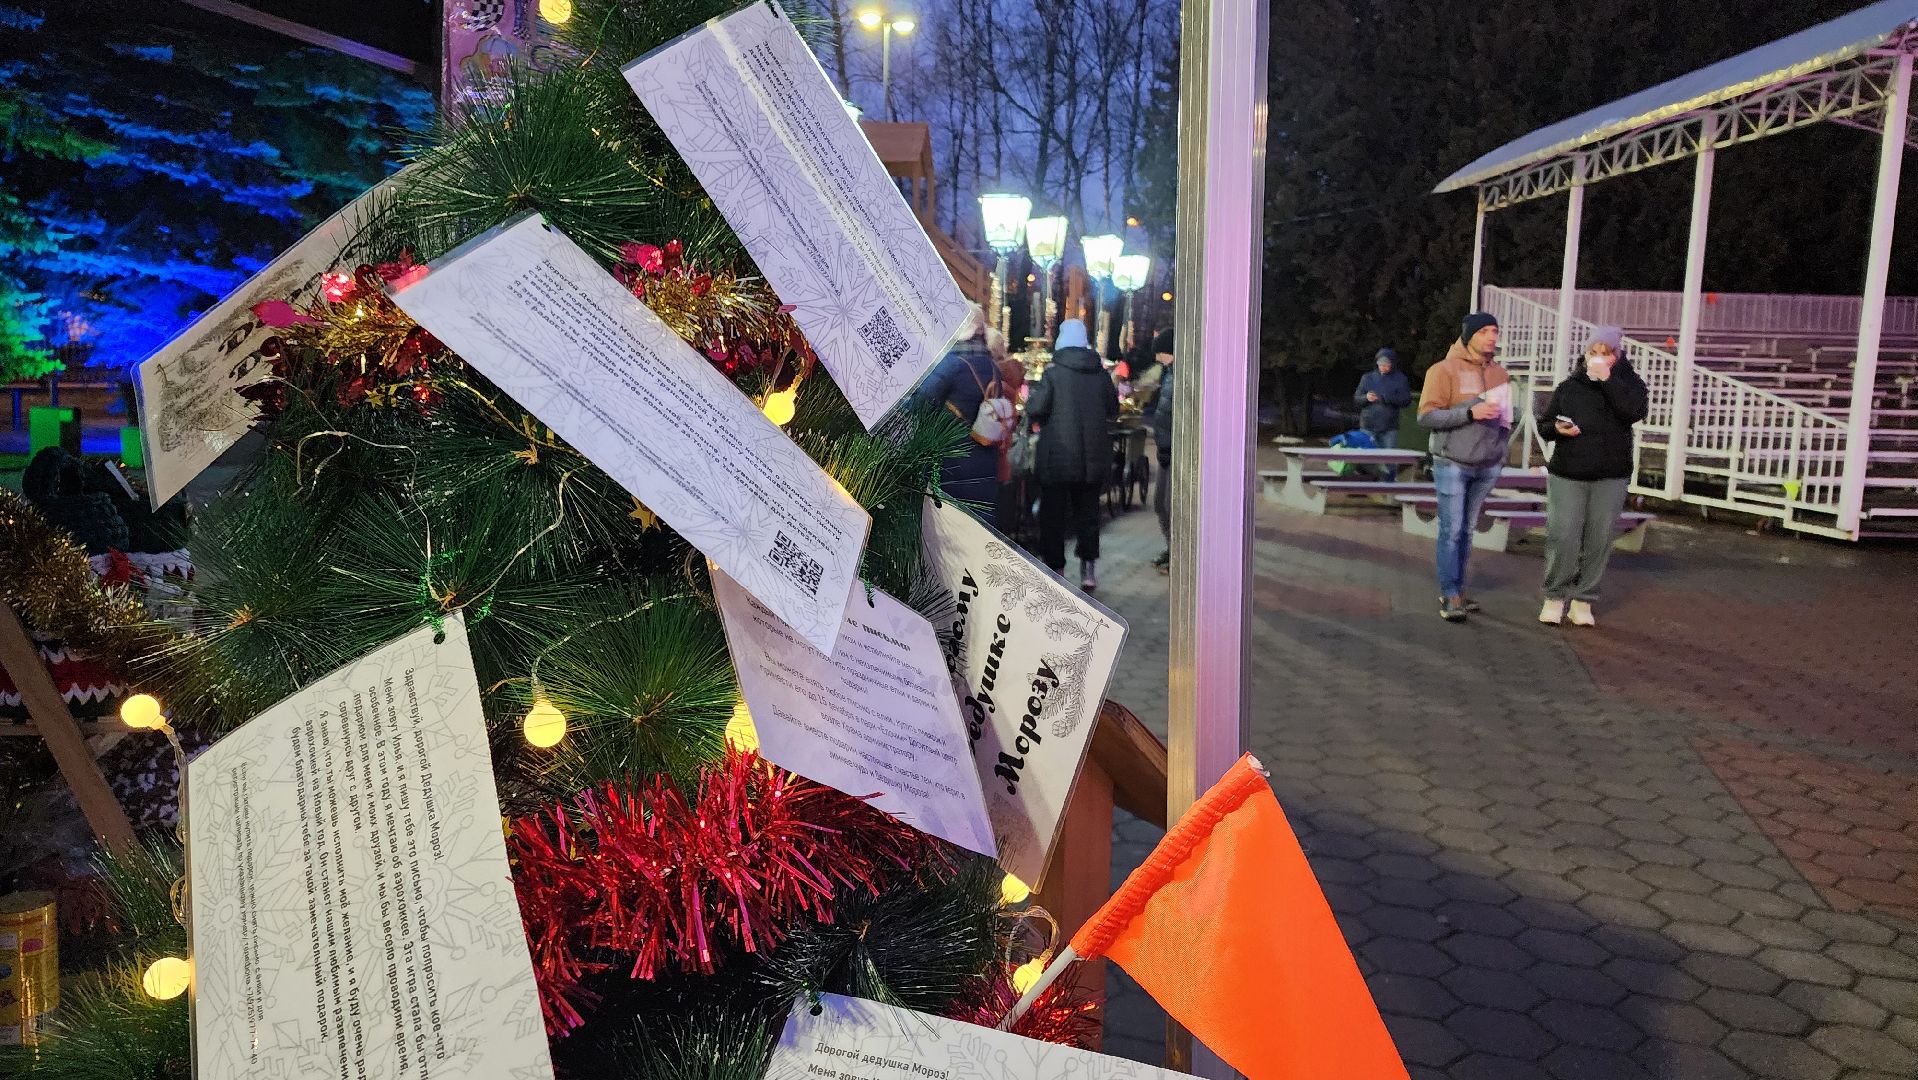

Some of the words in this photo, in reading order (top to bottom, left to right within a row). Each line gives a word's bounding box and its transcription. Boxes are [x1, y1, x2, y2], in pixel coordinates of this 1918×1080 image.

[384, 677, 394, 704] Меня
[404, 667, 423, 729] Здравствуй,
[964, 612, 1011, 756] едушке
[319, 711, 328, 719] Я
[353, 693, 366, 741] подарком
[369, 686, 382, 740] особенное.
[388, 706, 398, 732] зовут
[994, 658, 1060, 796] Морозу
[290, 727, 301, 758] будем
[321, 720, 329, 749] знаю,
[339, 701, 352, 757] соревнуясь
[376, 740, 385, 749] В
[305, 720, 319, 776] аэрохоккей
[324, 750, 332, 767] что
[359, 743, 369, 763] для
[377, 751, 387, 775] этом
[392, 733, 402, 764] Илья,
[413, 730, 431, 771] дорогой
[312, 778, 319, 791] на
[326, 769, 334, 784] ты
[345, 760, 355, 781] друг
[363, 763, 373, 790] меня
[295, 759, 307, 822] благодарны
[381, 777, 391, 800] году
[399, 783, 410, 810] пишу
[420, 773, 435, 821] Дедушка
[313, 792, 324, 827] Новый
[328, 785, 338, 827] можешь
[349, 794, 362, 831] другом.
[368, 801, 377, 827] моих
[301, 822, 311, 847] тебе
[316, 829, 325, 851] год.
[386, 812, 398, 853] мечтаю
[404, 812, 415, 837] тебе
[304, 849, 312, 862] за
[370, 830, 383, 871] друзей,
[407, 839, 417, 858] это
[429, 821, 444, 860] Мороз!
[319, 852, 328, 867] Он
[333, 830, 345, 886] исполнить
[392, 855, 403, 869] об
[305, 863, 317, 895] такой
[321, 869, 332, 906] станет
[377, 872, 385, 880] и
[378, 882, 387, 900] мы
[410, 860, 423, 904] письмо,
[339, 888, 350, 909] моё
[381, 901, 390, 918] бы
[394, 871, 409, 940] аэрохоккее.
[325, 909, 335, 946] нашим
[341, 912, 353, 966] желание,
[417, 906, 429, 941] чтобы
[308, 897, 325, 987] замечательный
[382, 920, 395, 961] весело
[403, 941, 413, 963] Эта
[329, 949, 342, 1005] любимым
[348, 967, 355, 975] и
[405, 965, 417, 993] игра
[422, 944, 437, 1007] попросить
[348, 987, 360, 1016] буду
[386, 963, 403, 1030] проводили
[410, 996, 422, 1032] стала
[353, 1020, 363, 1056] очень
[415, 1034, 426, 1053] бы
[431, 1009, 445, 1059] кое-что
[394, 1032, 408, 1076] время,
[418, 1055, 429, 1080] отл
[815, 1042, 860, 1060] Дорогой
[861, 1053, 910, 1071] дедушка
[911, 1062, 950, 1080] Мороз!
[807, 1063, 837, 1079] Меня
